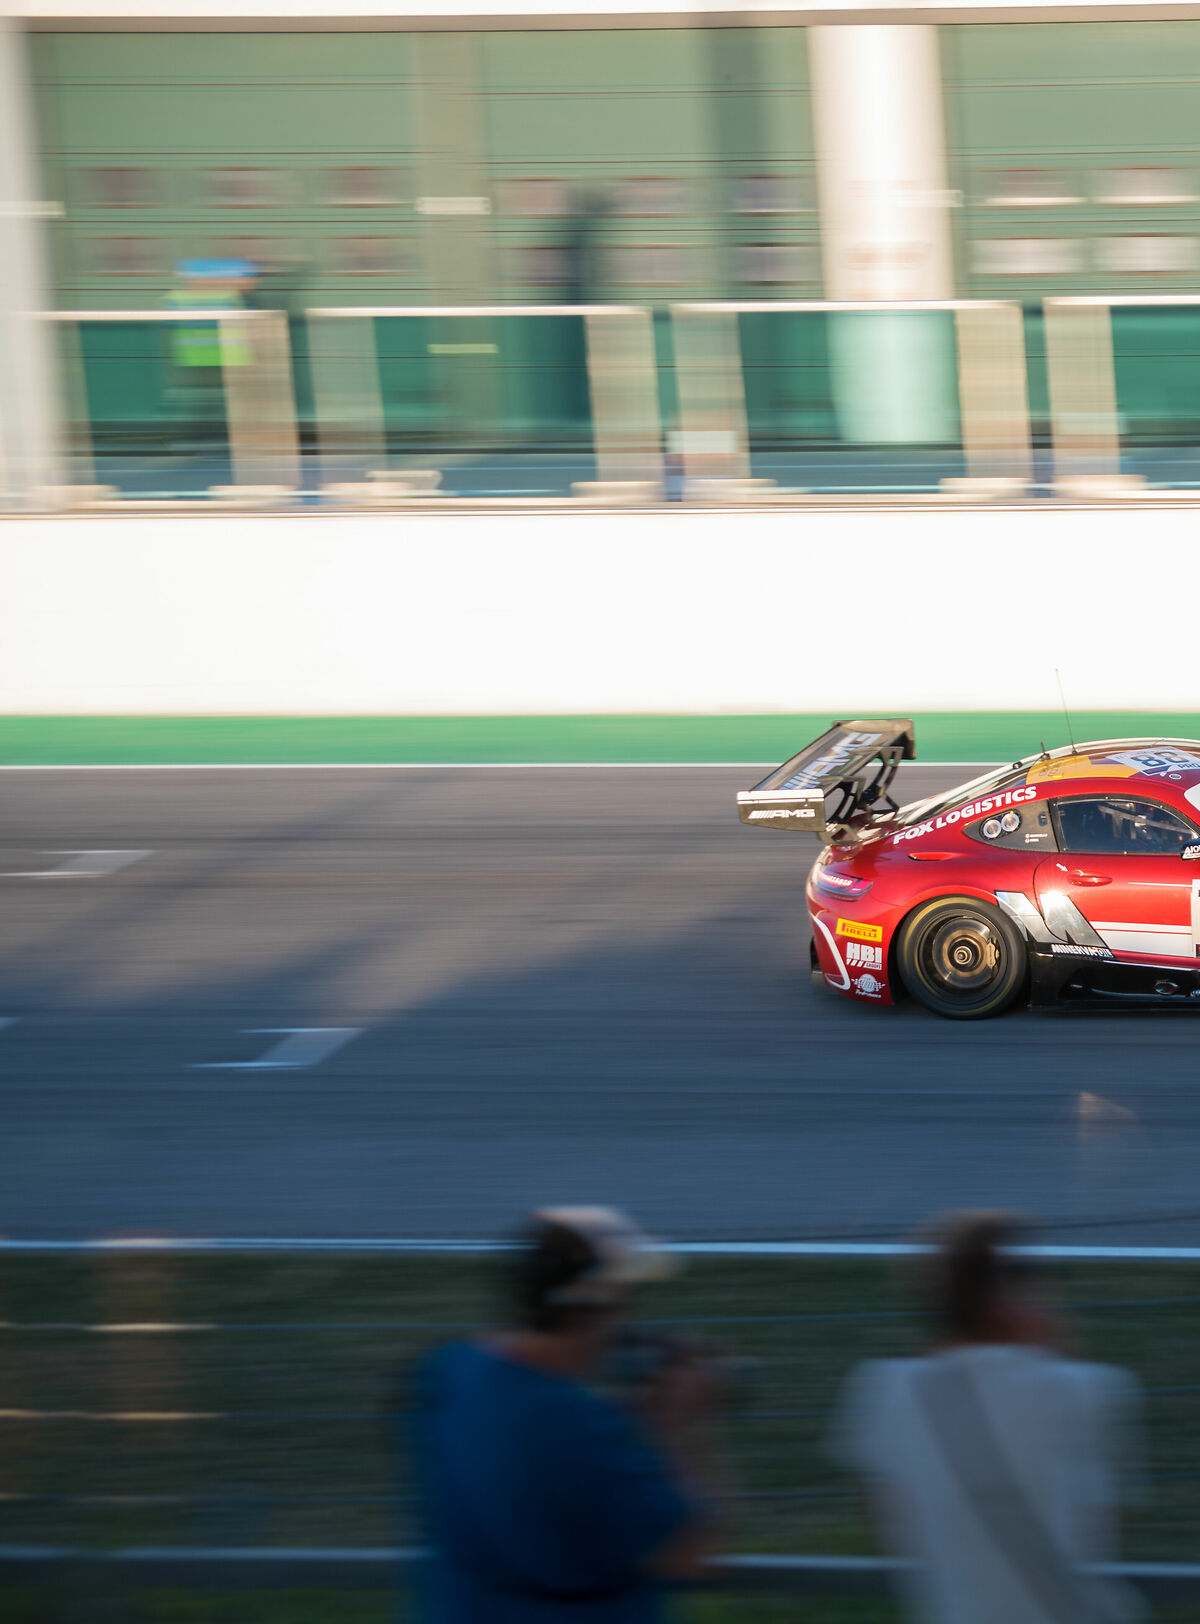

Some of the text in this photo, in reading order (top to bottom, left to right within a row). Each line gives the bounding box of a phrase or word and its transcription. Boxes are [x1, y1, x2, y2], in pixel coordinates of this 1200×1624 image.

[1130, 751, 1189, 767] 88
[1178, 762, 1200, 770] PRO
[769, 809, 815, 818] AMG
[893, 785, 1037, 845] FOX LOGISTICS
[842, 922, 877, 938] PIRELLI
[846, 942, 882, 963] HBI
